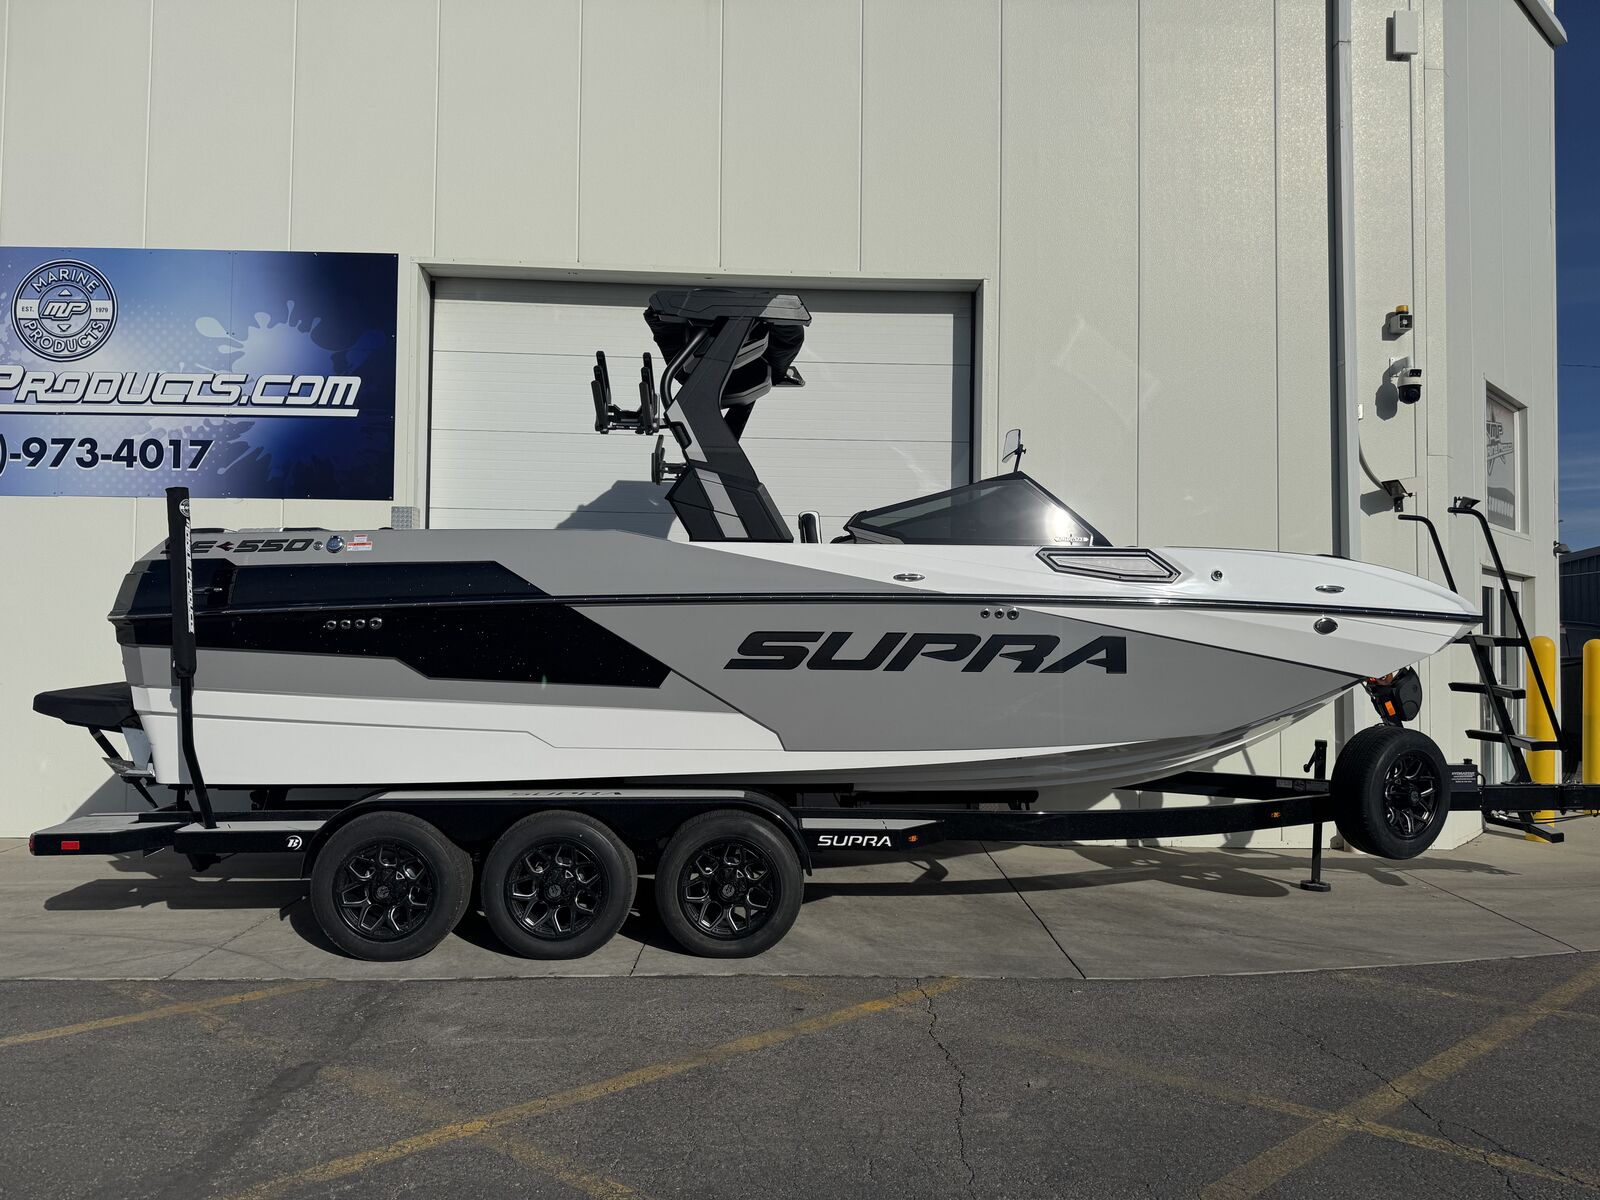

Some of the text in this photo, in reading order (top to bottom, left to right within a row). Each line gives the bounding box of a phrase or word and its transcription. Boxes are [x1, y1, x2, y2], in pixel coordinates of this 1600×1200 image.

[32, 269, 100, 293] MARINE
[24, 320, 105, 352] PRODUCTS
[233, 539, 314, 553] 550
[723, 631, 1127, 674] SUPRA
[818, 835, 892, 847] SUPRA
